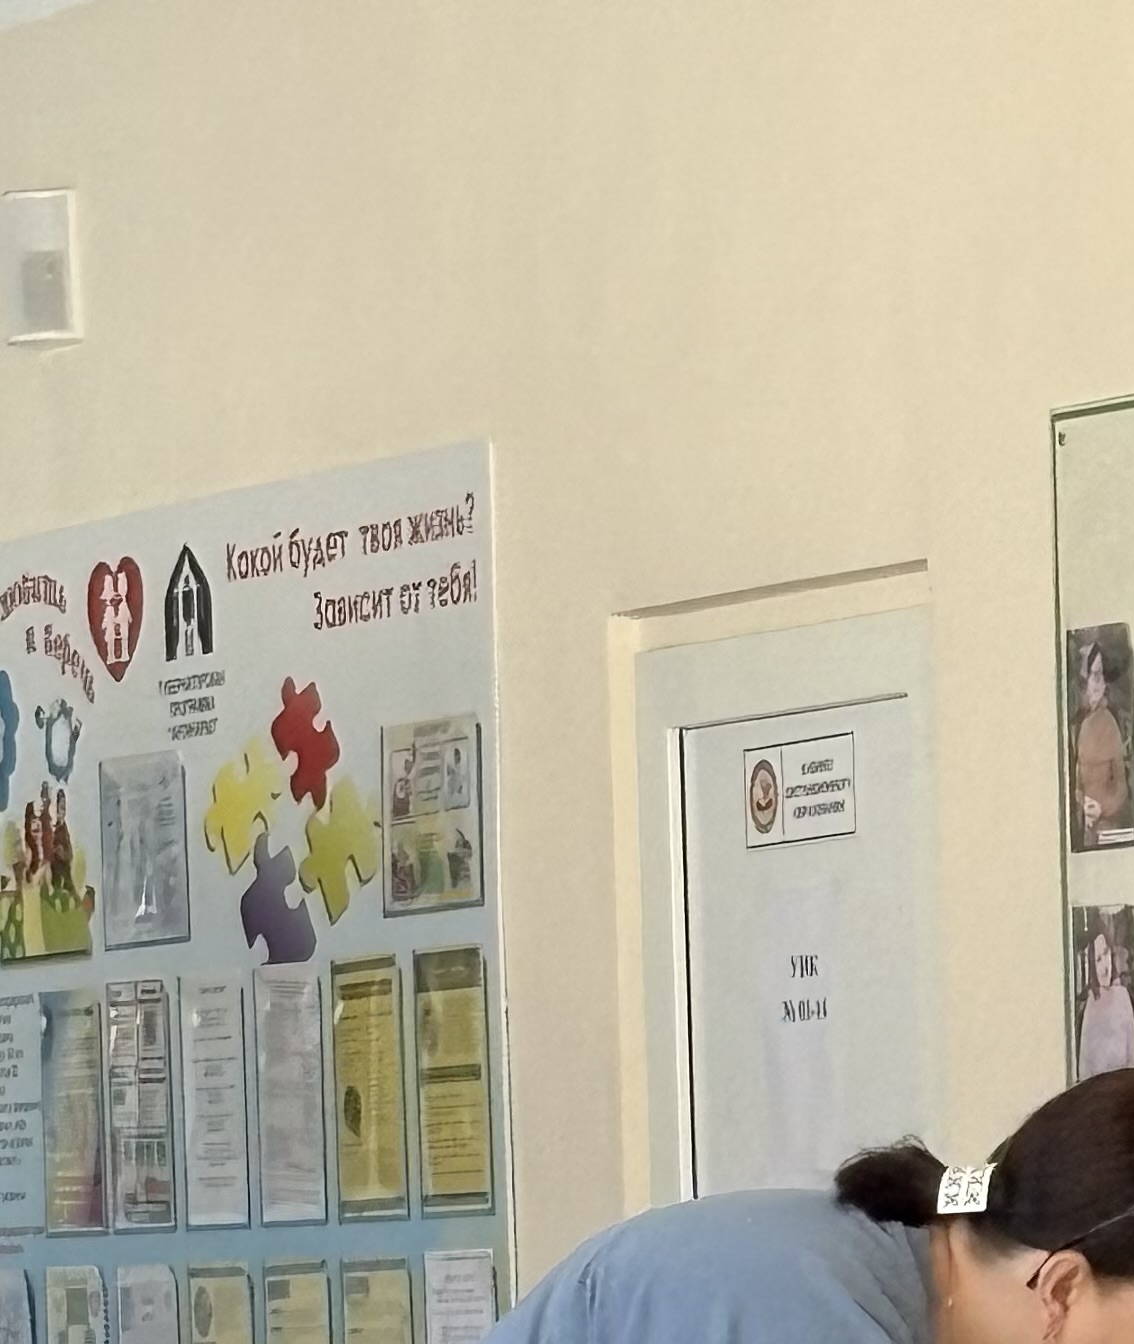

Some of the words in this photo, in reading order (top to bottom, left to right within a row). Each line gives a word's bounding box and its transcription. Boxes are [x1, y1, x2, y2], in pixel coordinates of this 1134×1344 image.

[289, 528, 349, 577] будет
[358, 518, 403, 555] твоя
[313, 587, 394, 631] Зависит
[400, 580, 422, 615] от
[427, 559, 477, 610] тебя!
